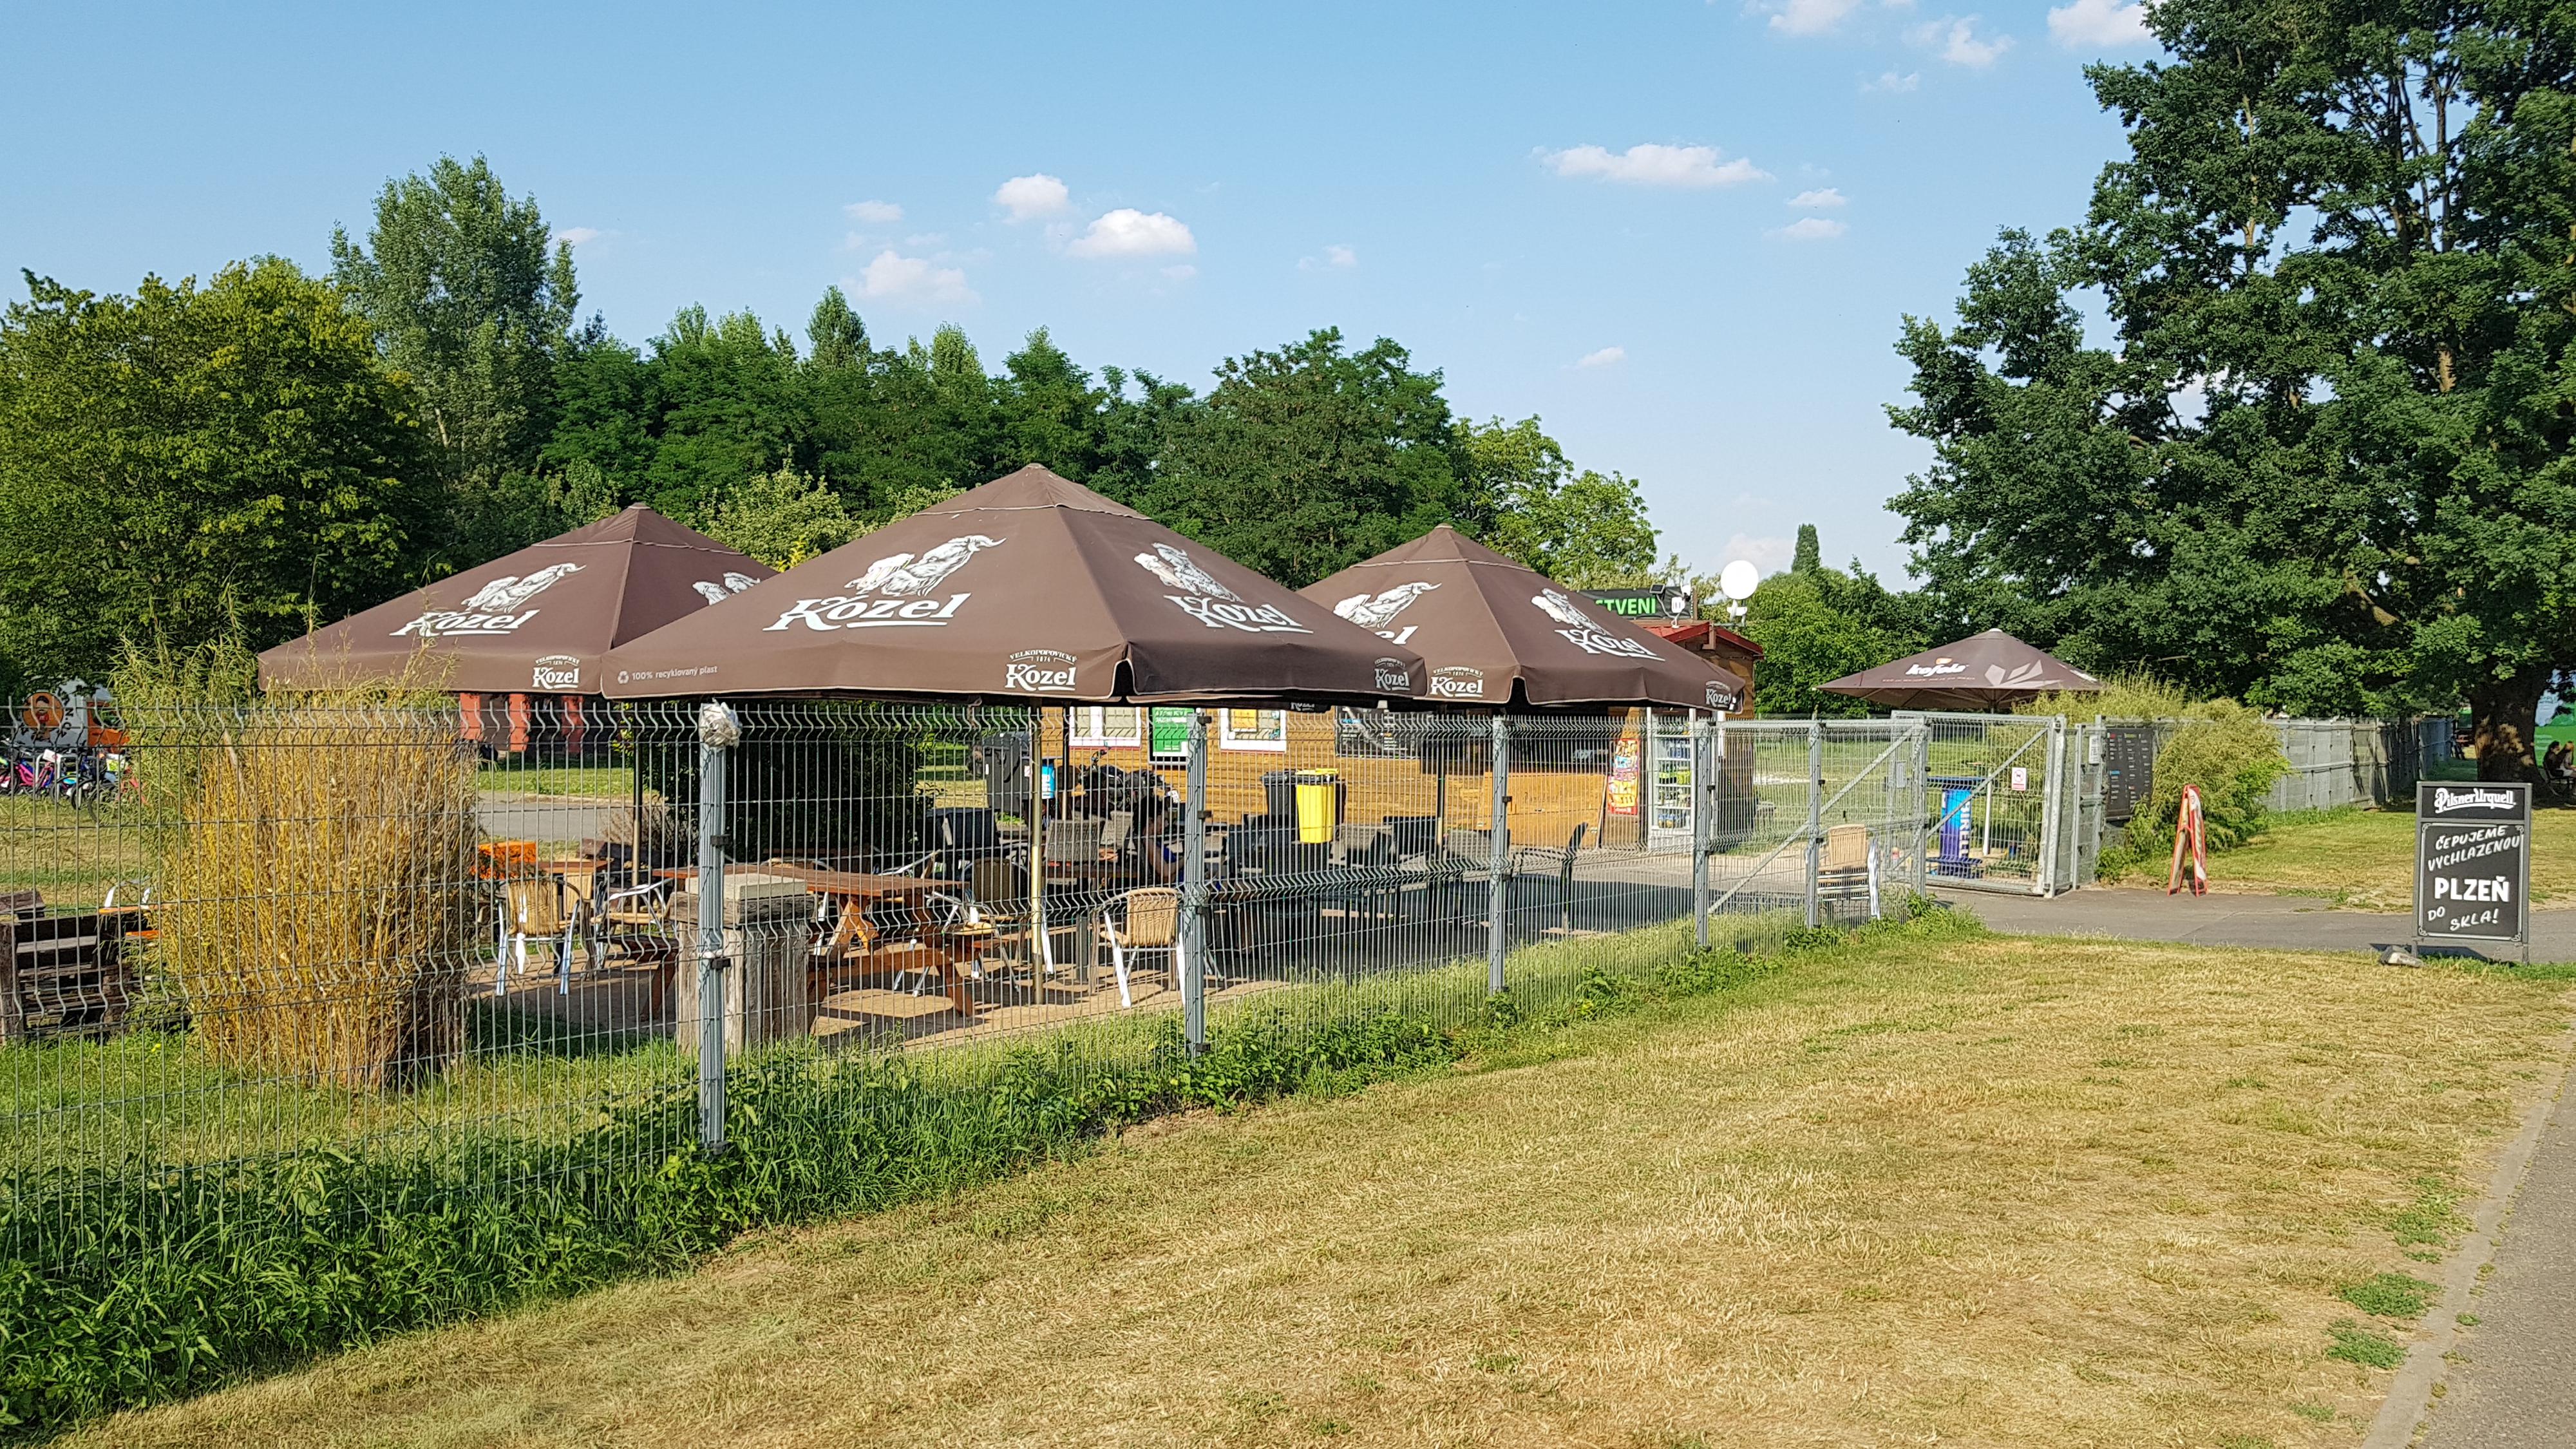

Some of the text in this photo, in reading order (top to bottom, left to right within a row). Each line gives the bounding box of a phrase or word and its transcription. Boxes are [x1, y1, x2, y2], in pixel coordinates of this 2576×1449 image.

[389, 609, 540, 638] Kozel
[762, 592, 971, 631] Kozel
[1163, 595, 1314, 633] Kozel
[1555, 629, 1666, 662] Kozel
[532, 667, 580, 690] Kozel
[632, 665, 718, 681] 100% recyklovaný plast
[1005, 663, 1077, 692] Kozel
[1374, 668, 1411, 691] Kozel
[1430, 676, 1483, 697] Kozel
[1705, 688, 1732, 708] Kozel
[2434, 787, 2476, 814] Pilsner
[2436, 825, 2508, 851] ČEPUJEME
[2428, 835, 2521, 872] VYCHLAZENOU
[2434, 876, 2510, 902] PLZEŇ
[2427, 906, 2499, 932] DO SKLA!
